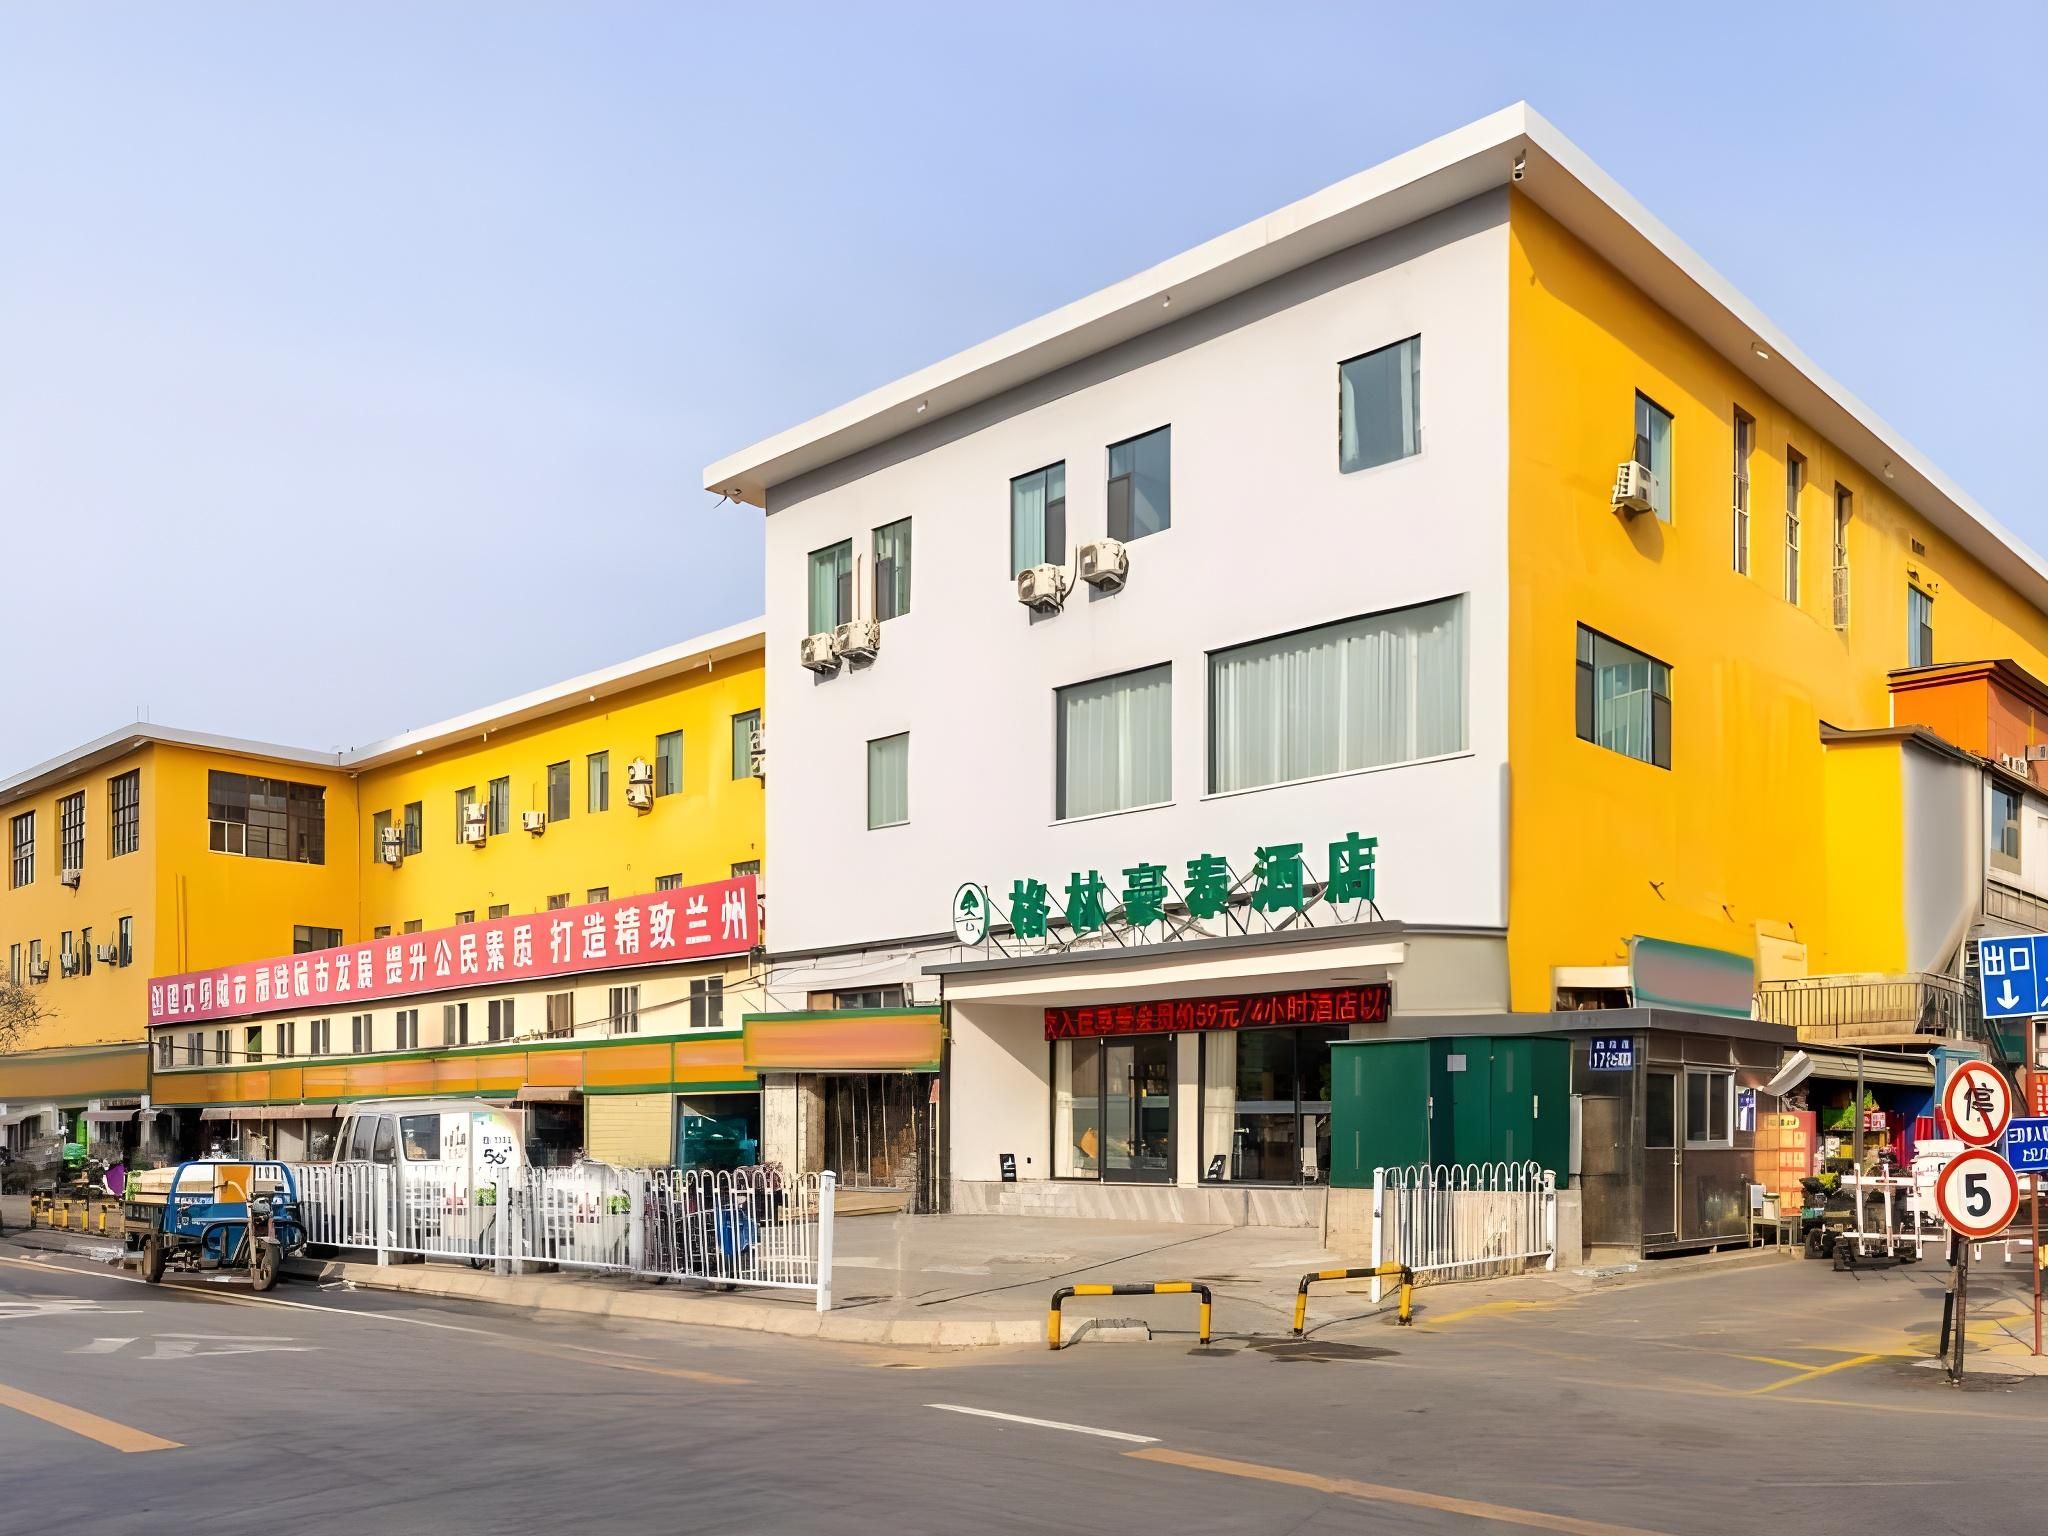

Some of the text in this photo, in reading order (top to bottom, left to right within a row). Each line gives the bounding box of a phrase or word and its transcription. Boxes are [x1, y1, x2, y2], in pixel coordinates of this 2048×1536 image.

[1009, 832, 1379, 939] 格林豪泰酒店
[386, 923, 533, 985] 提升公民素质
[550, 887, 748, 964] 打造精致兰州
[1983, 944, 2030, 976] 出口
[1963, 1082, 1995, 1123] 停
[1964, 1172, 1992, 1218] 5
